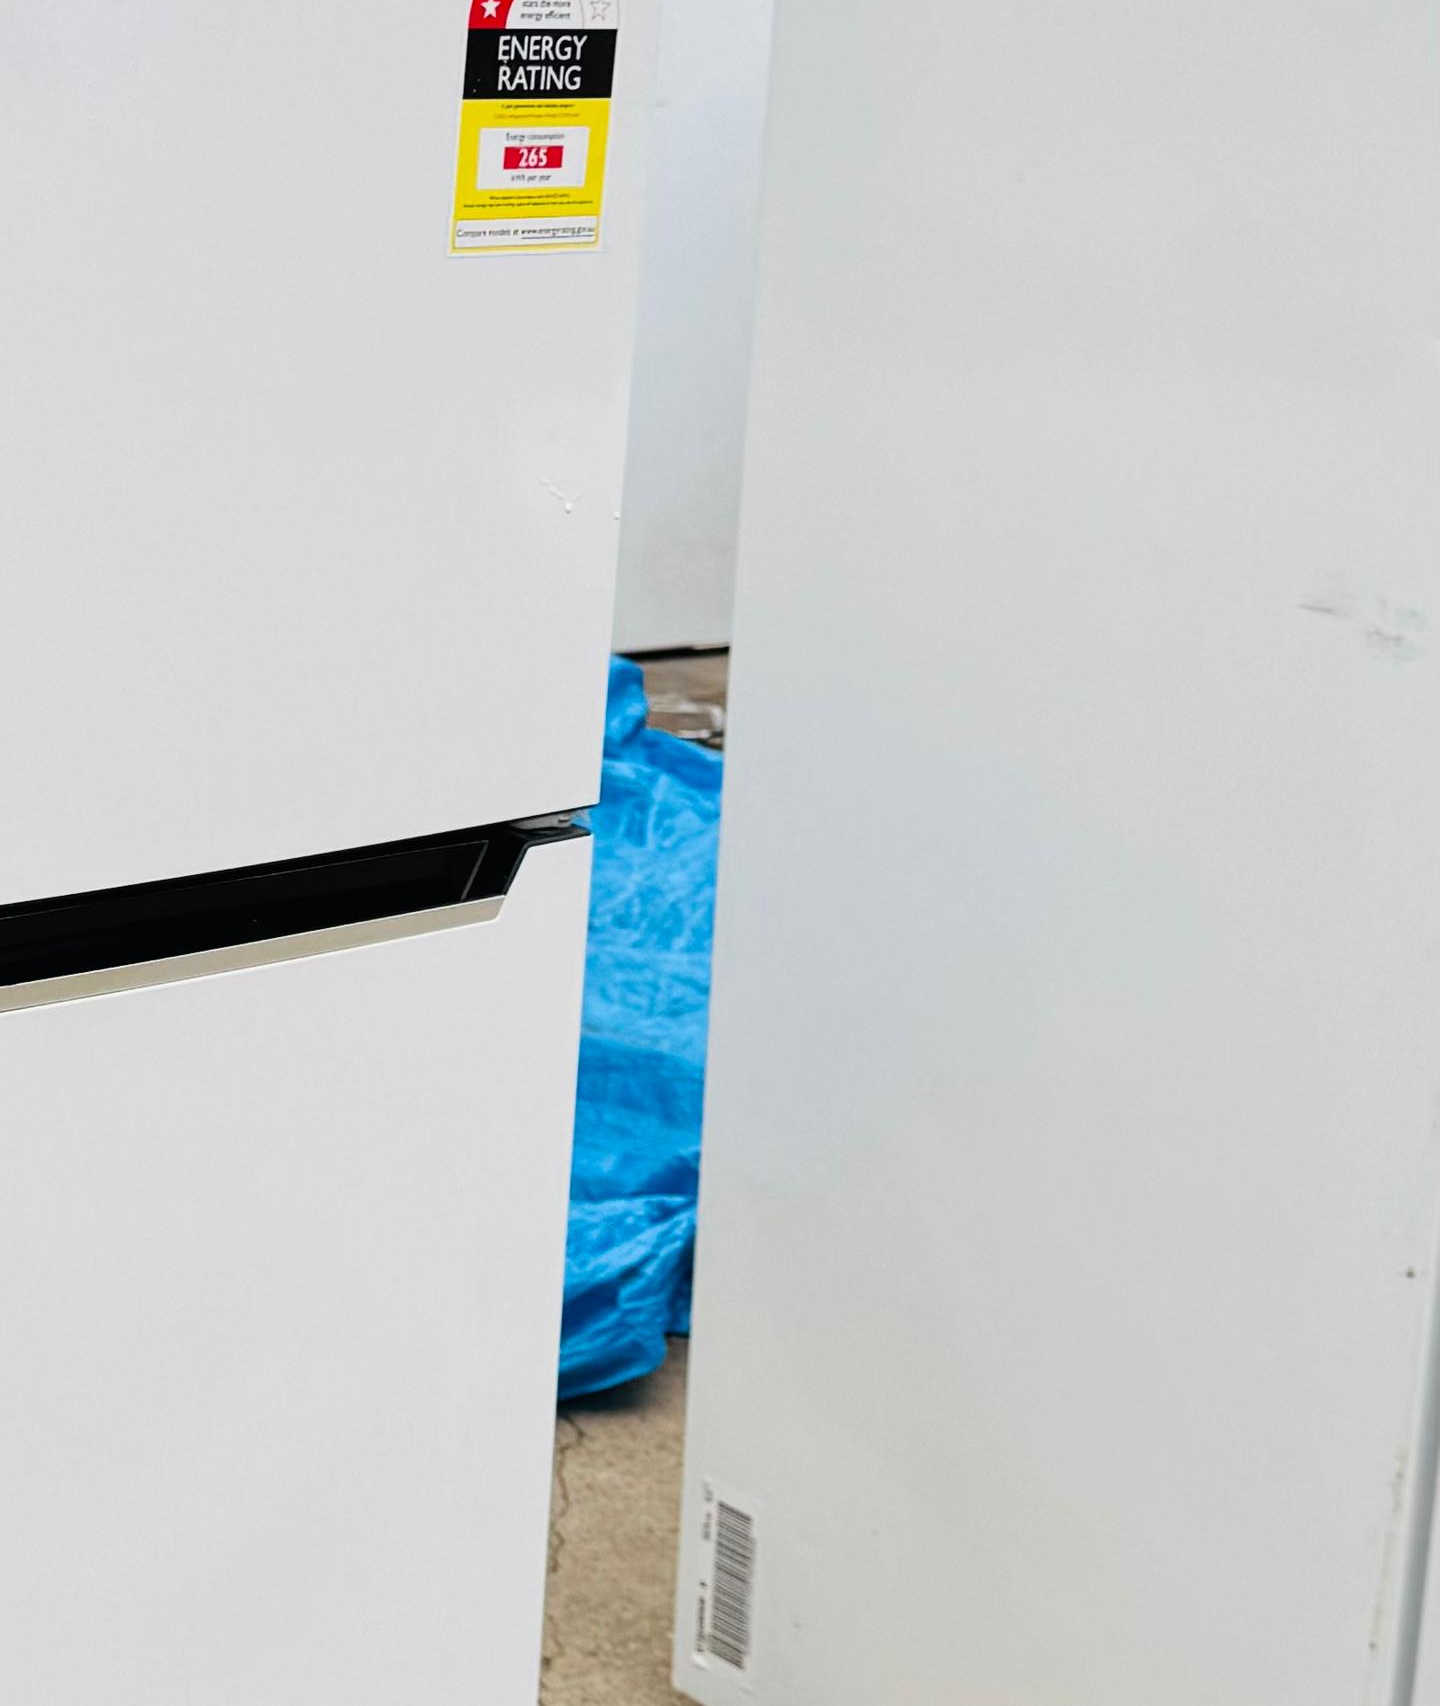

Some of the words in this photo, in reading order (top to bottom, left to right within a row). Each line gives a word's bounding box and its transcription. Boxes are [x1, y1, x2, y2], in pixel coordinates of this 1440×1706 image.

[498, 35, 588, 62] ENERGY
[498, 65, 582, 92] RATING
[518, 149, 548, 167] 265
